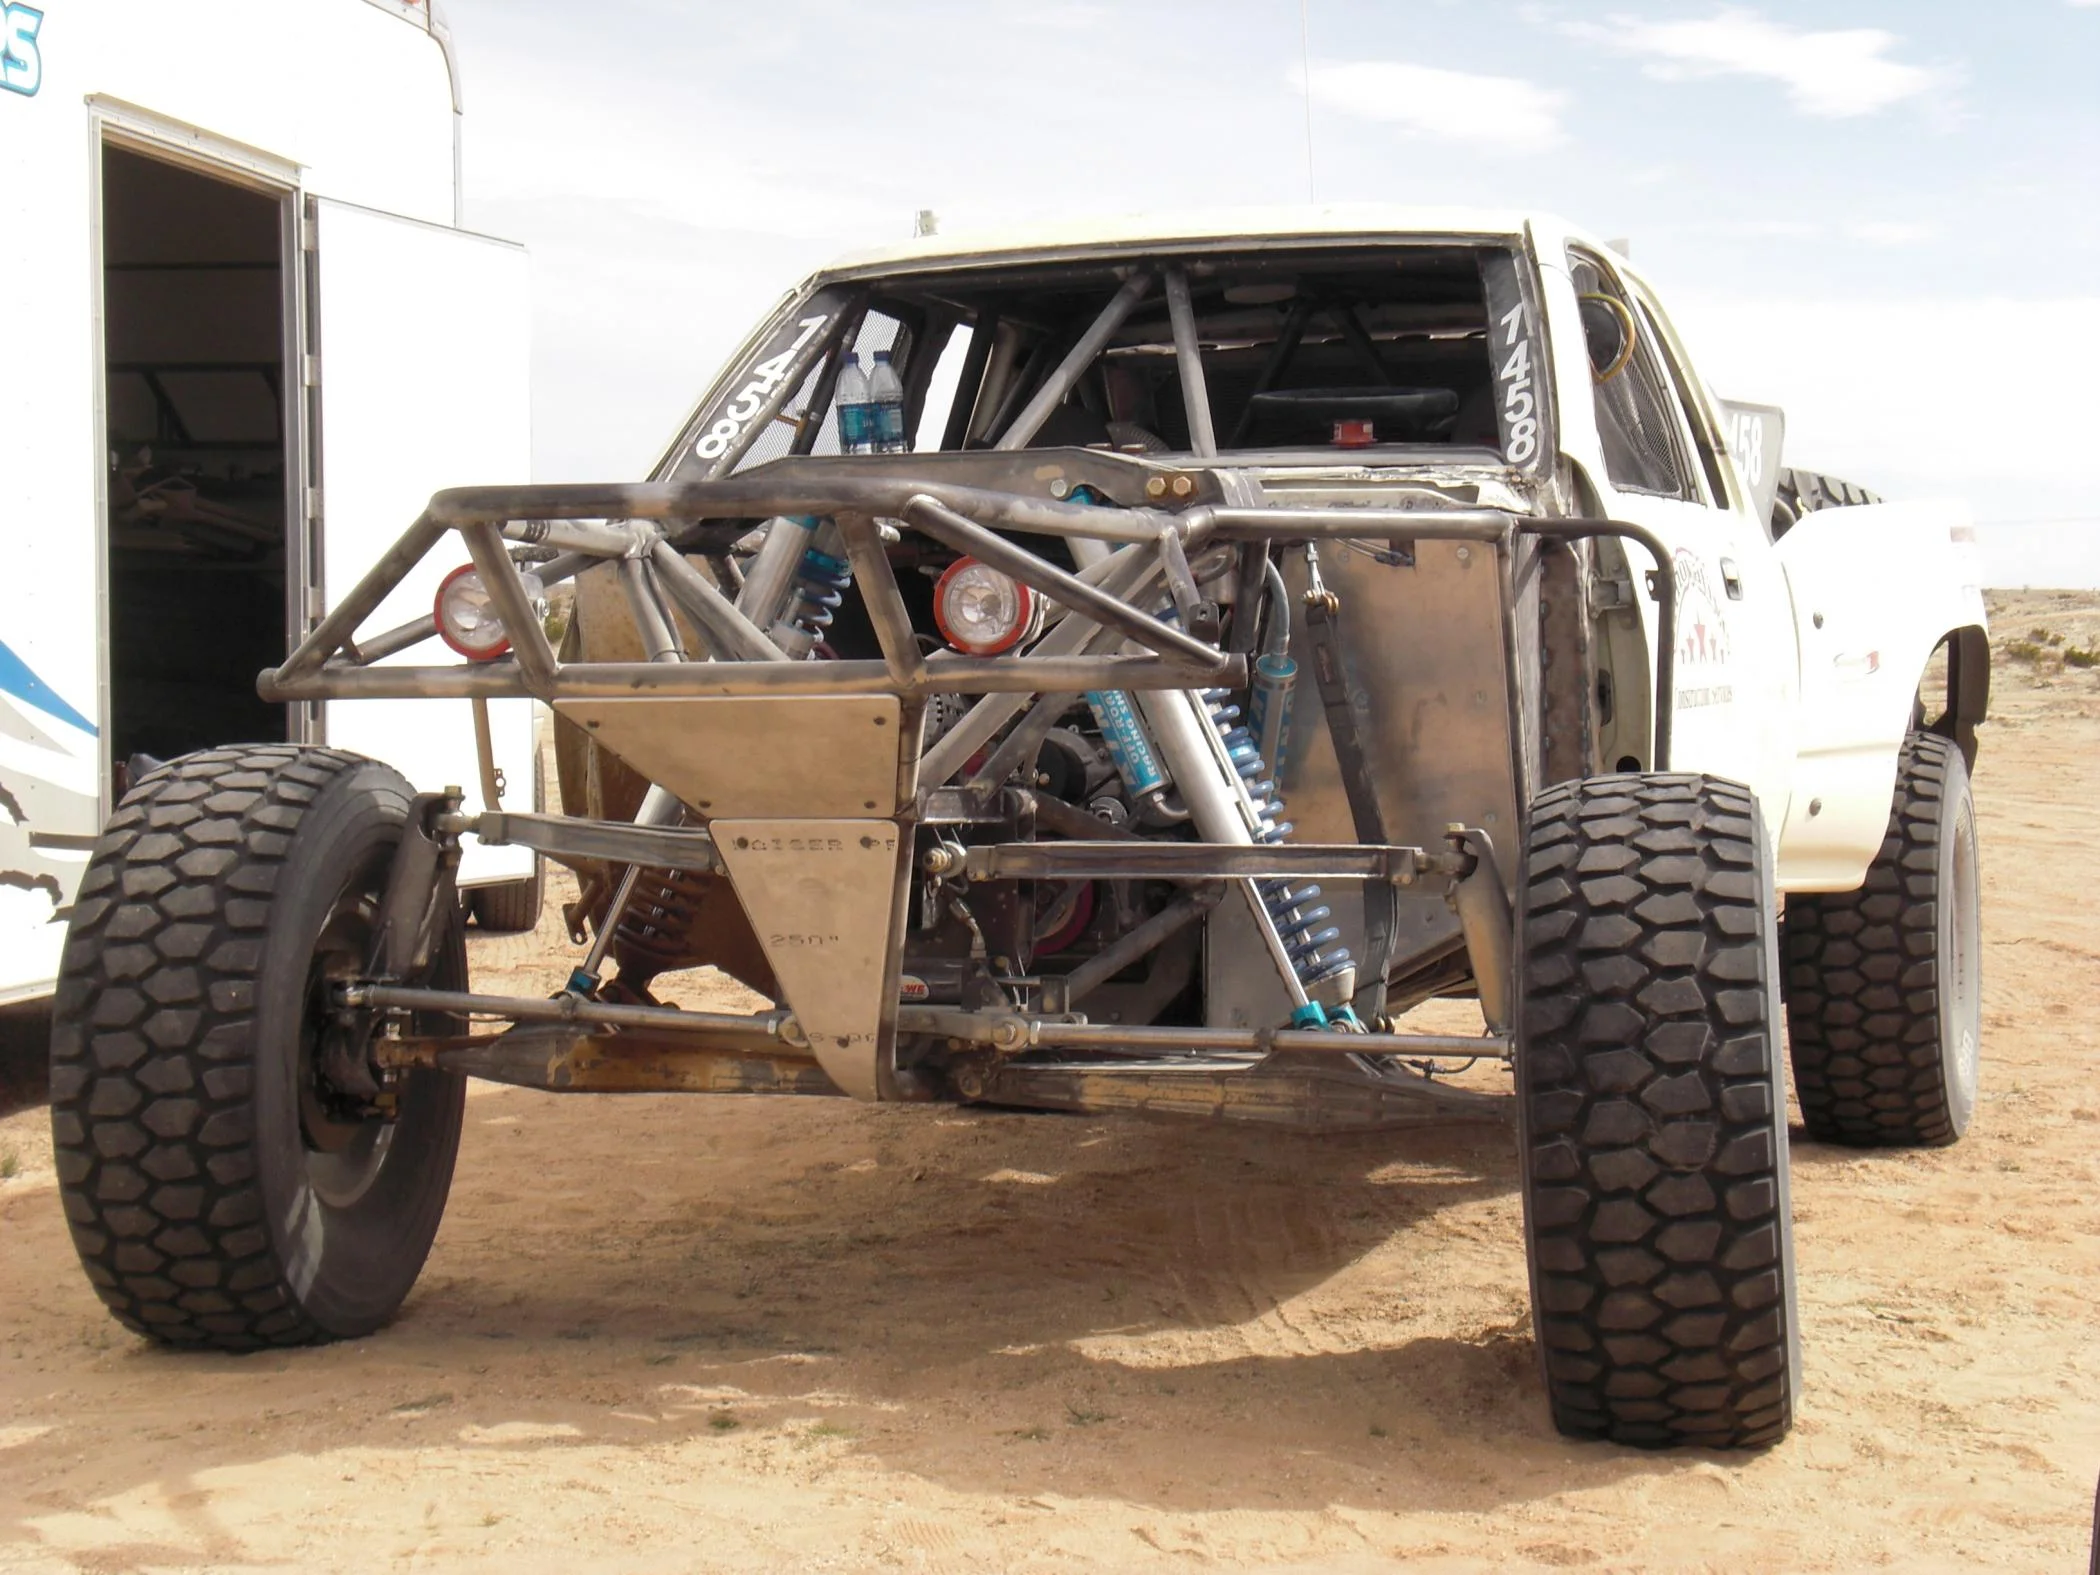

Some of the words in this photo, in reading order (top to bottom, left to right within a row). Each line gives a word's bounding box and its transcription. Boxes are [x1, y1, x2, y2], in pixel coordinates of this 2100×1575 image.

[696, 314, 828, 459] 1458
[1725, 412, 1763, 487] 458
[1104, 691, 1140, 764] OFF-ROA
[1125, 717, 1157, 777] RACING
